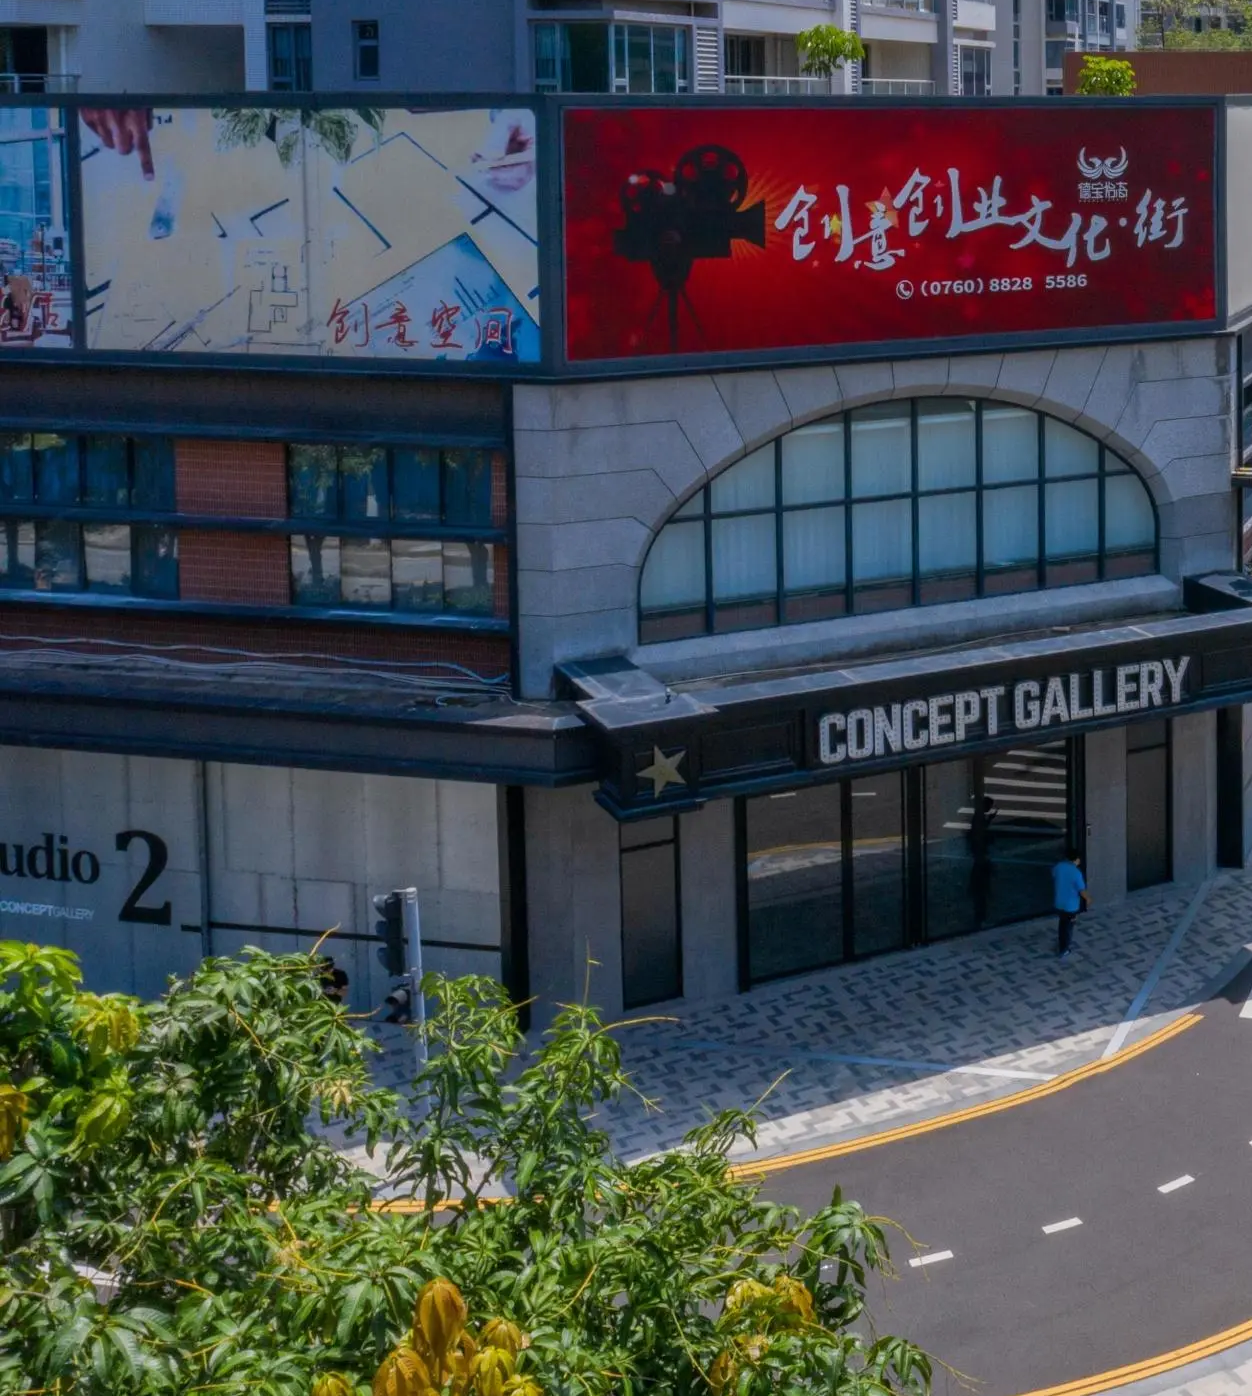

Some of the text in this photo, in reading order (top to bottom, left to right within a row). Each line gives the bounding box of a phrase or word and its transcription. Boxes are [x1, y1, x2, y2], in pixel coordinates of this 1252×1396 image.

[921, 273, 1088, 297] (0760) 8828 5586
[326, 298, 513, 354] 创意空间
[819, 686, 1004, 765] CONCEPT
[1014, 655, 1191, 730] GALLERY
[0, 829, 172, 926] udio 2
